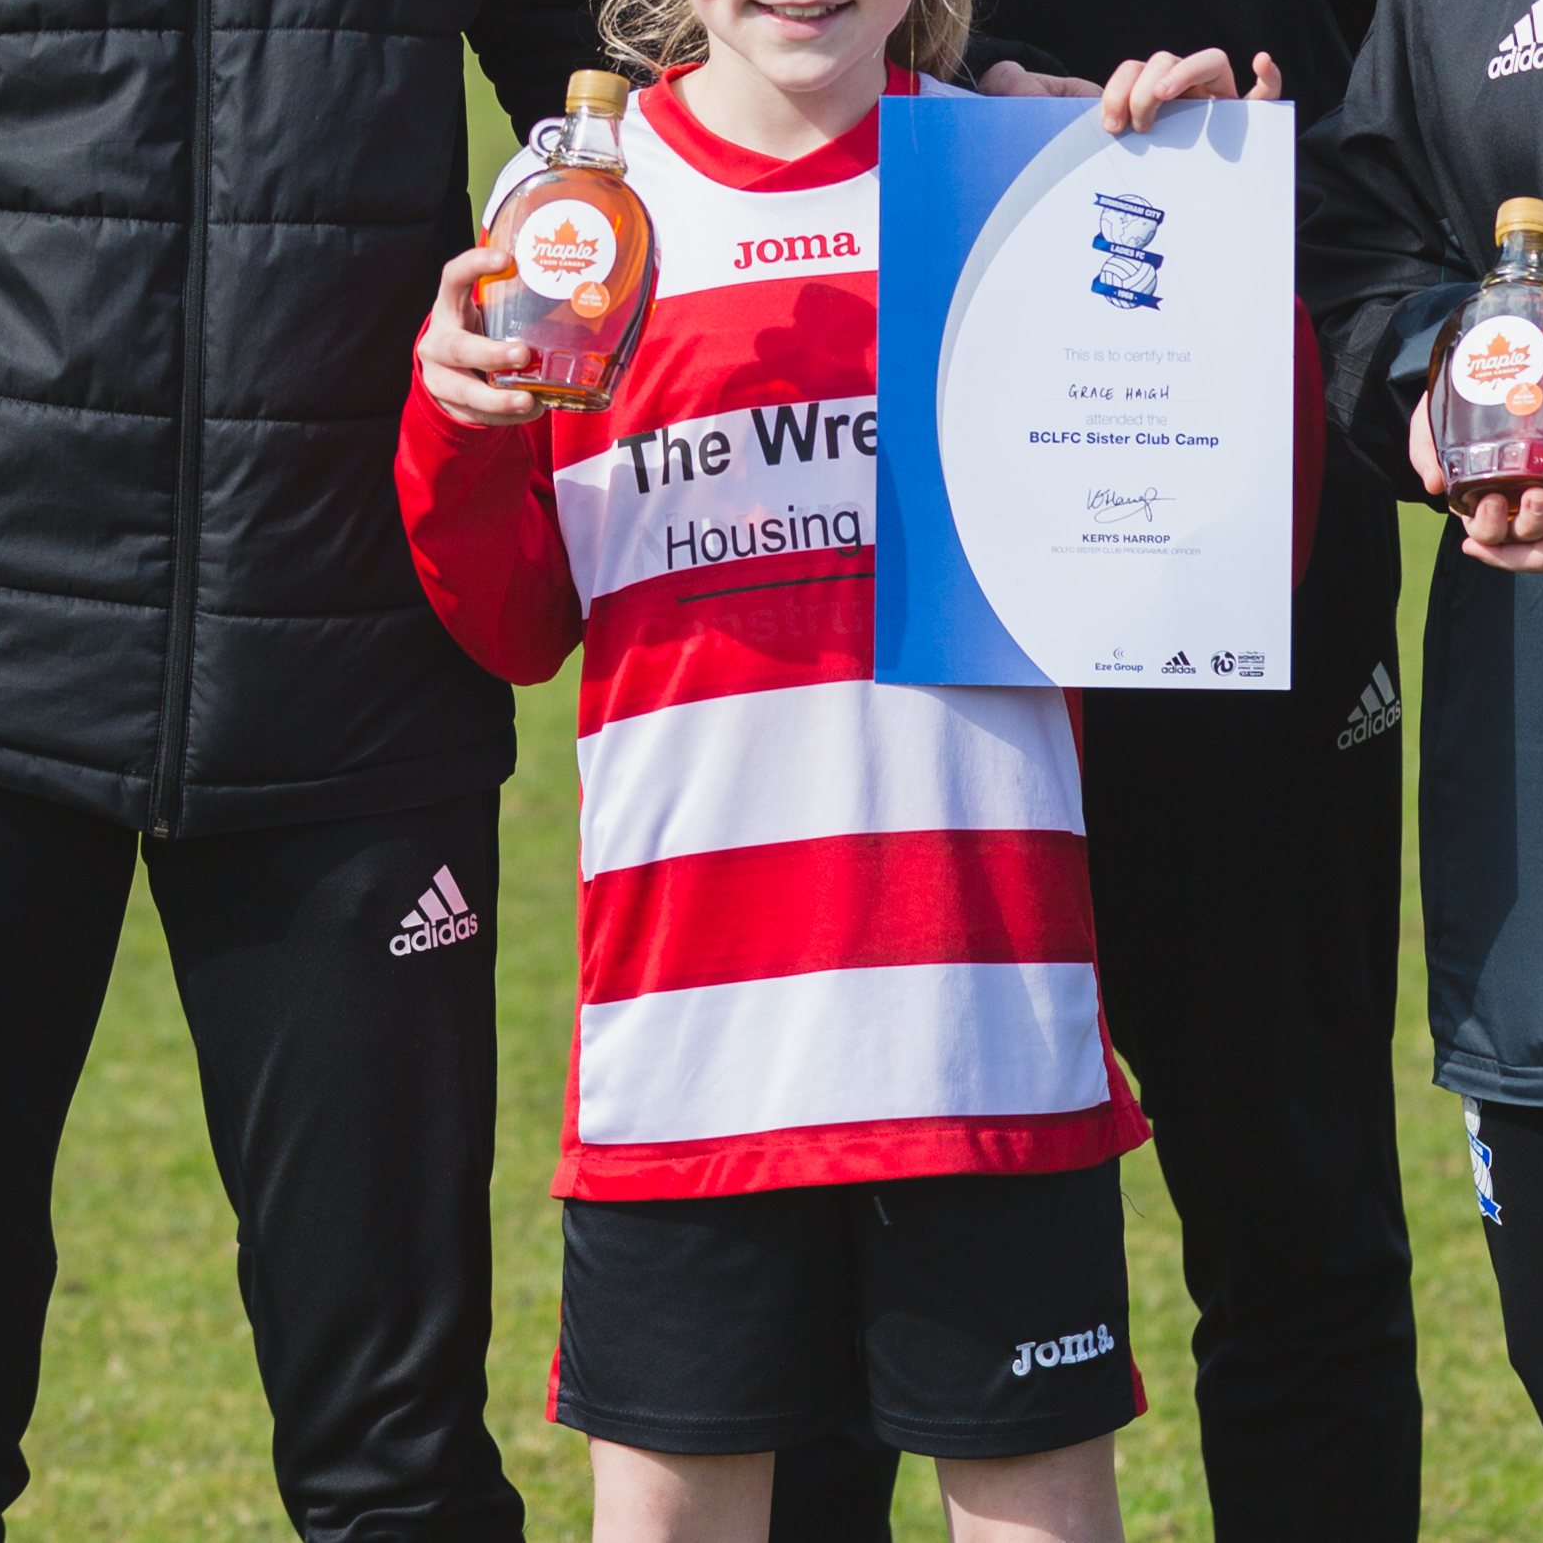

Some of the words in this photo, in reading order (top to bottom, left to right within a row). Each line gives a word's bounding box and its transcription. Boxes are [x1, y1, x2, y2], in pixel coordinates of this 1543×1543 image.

[1144, 208, 1162, 220] CITY
[535, 243, 593, 261] maple
[1135, 250, 1146, 260] FC
[558, 259, 586, 268] CANADA
[1063, 347, 1090, 362] This
[1093, 349, 1105, 362] is
[1107, 349, 1121, 363] to
[1123, 349, 1164, 365] certify
[1166, 349, 1191, 363] that
[1470, 351, 1526, 371] maple
[1475, 370, 1493, 378] FROM
[1493, 367, 1520, 376] CANADA
[1068, 383, 1114, 400] GRACE
[1125, 385, 1170, 400] HAIGH
[1085, 412, 1143, 426] attended
[1147, 413, 1168, 426] the
[1029, 431, 1081, 444] BCLFC
[1086, 431, 1131, 445] Sister
[1135, 432, 1170, 446] Club
[1175, 433, 1219, 448] Camp
[617, 425, 732, 495] The
[666, 504, 863, 570] Housing
[1082, 534, 1120, 543] KERYS
[1123, 534, 1171, 544] HARROP
[1076, 546, 1101, 554] SISTER
[1101, 546, 1122, 555] CLUB
[1122, 547, 1170, 556] PROGRAMME
[1171, 547, 1202, 556] OFFICER
[1095, 662, 1112, 671] Eze
[1114, 662, 1144, 674] Group
[1161, 664, 1196, 675] adidas
[1337, 699, 1402, 750] adidas
[389, 913, 479, 957] adidas
